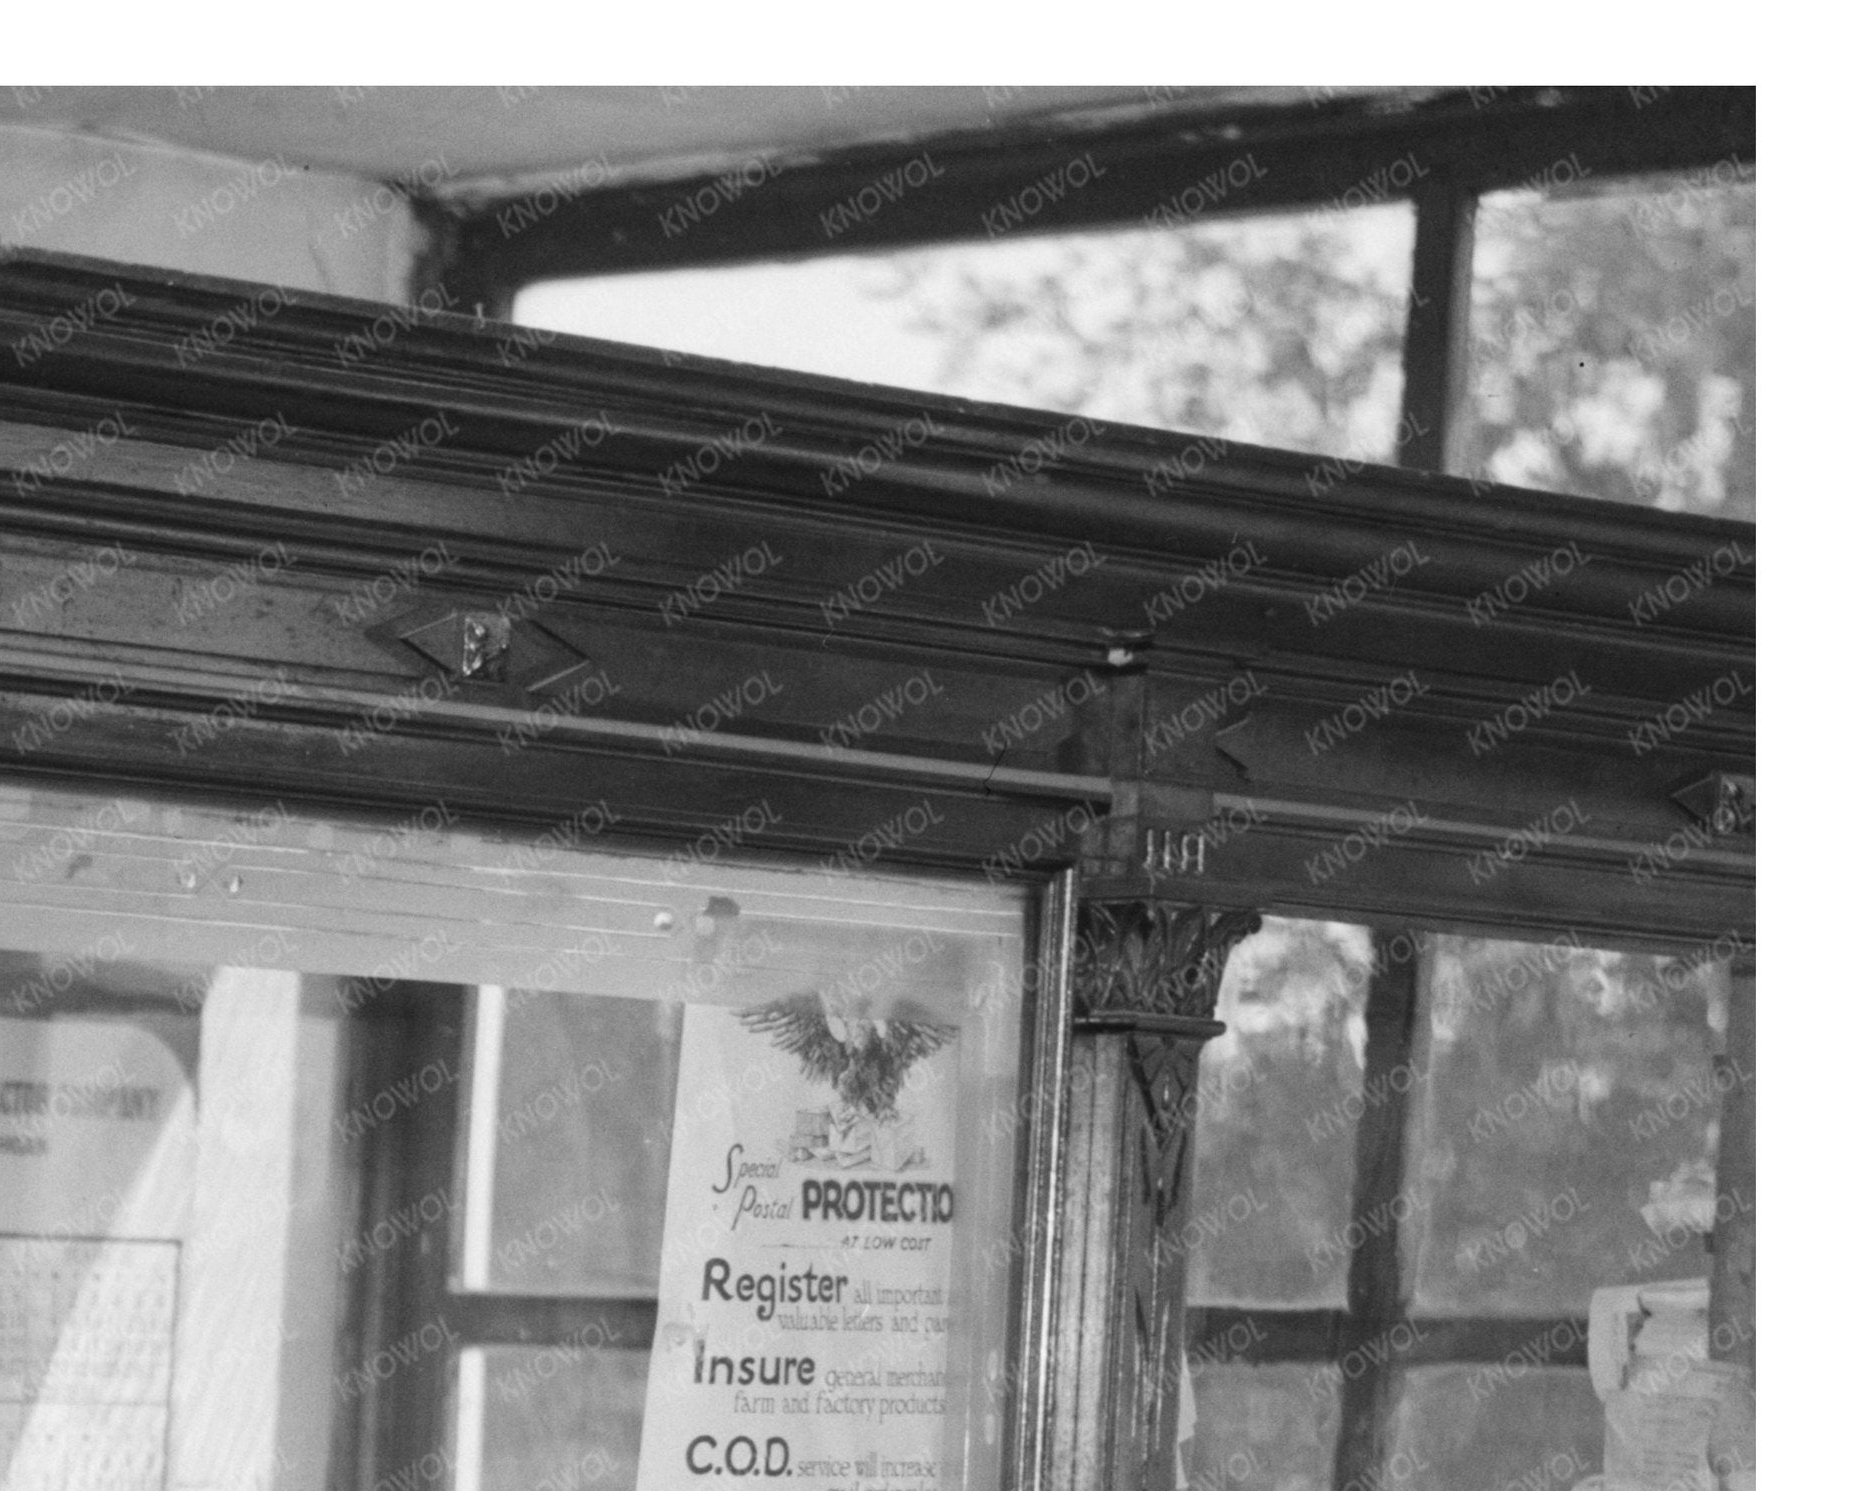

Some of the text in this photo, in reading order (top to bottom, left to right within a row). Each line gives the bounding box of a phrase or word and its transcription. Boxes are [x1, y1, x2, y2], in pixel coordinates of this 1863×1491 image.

[711, 1143, 783, 1193] Special
[730, 1179, 954, 1231] Postal PROTECTIO
[841, 1235, 933, 1251] AT LOW COST
[701, 1257, 848, 1322] Register
[891, 1309, 918, 1333] and
[692, 1337, 816, 1386] Insure
[824, 1361, 882, 1393] general
[734, 1389, 776, 1415] farm
[782, 1391, 811, 1415] and
[815, 1389, 877, 1420] factory
[685, 1434, 793, 1477] C.O.D.
[796, 1455, 852, 1478] service
[854, 1451, 878, 1478] will
